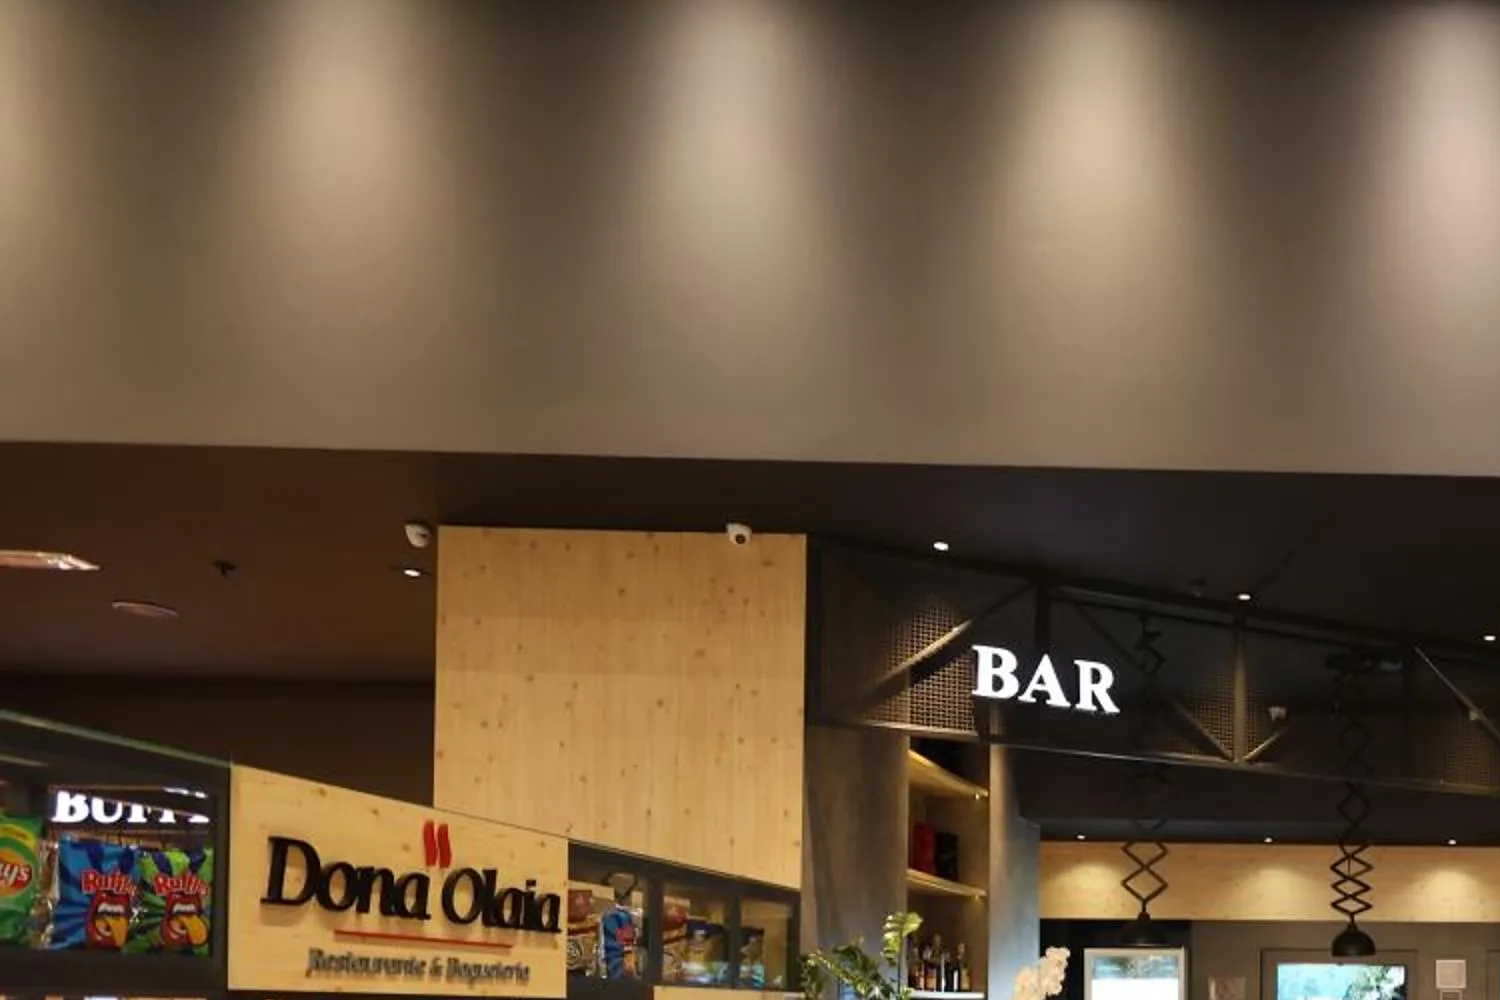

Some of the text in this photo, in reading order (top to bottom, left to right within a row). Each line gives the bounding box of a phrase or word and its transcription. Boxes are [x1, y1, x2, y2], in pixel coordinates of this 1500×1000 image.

[971, 645, 1121, 713] BAR
[260, 835, 562, 933] Dona Olaia
